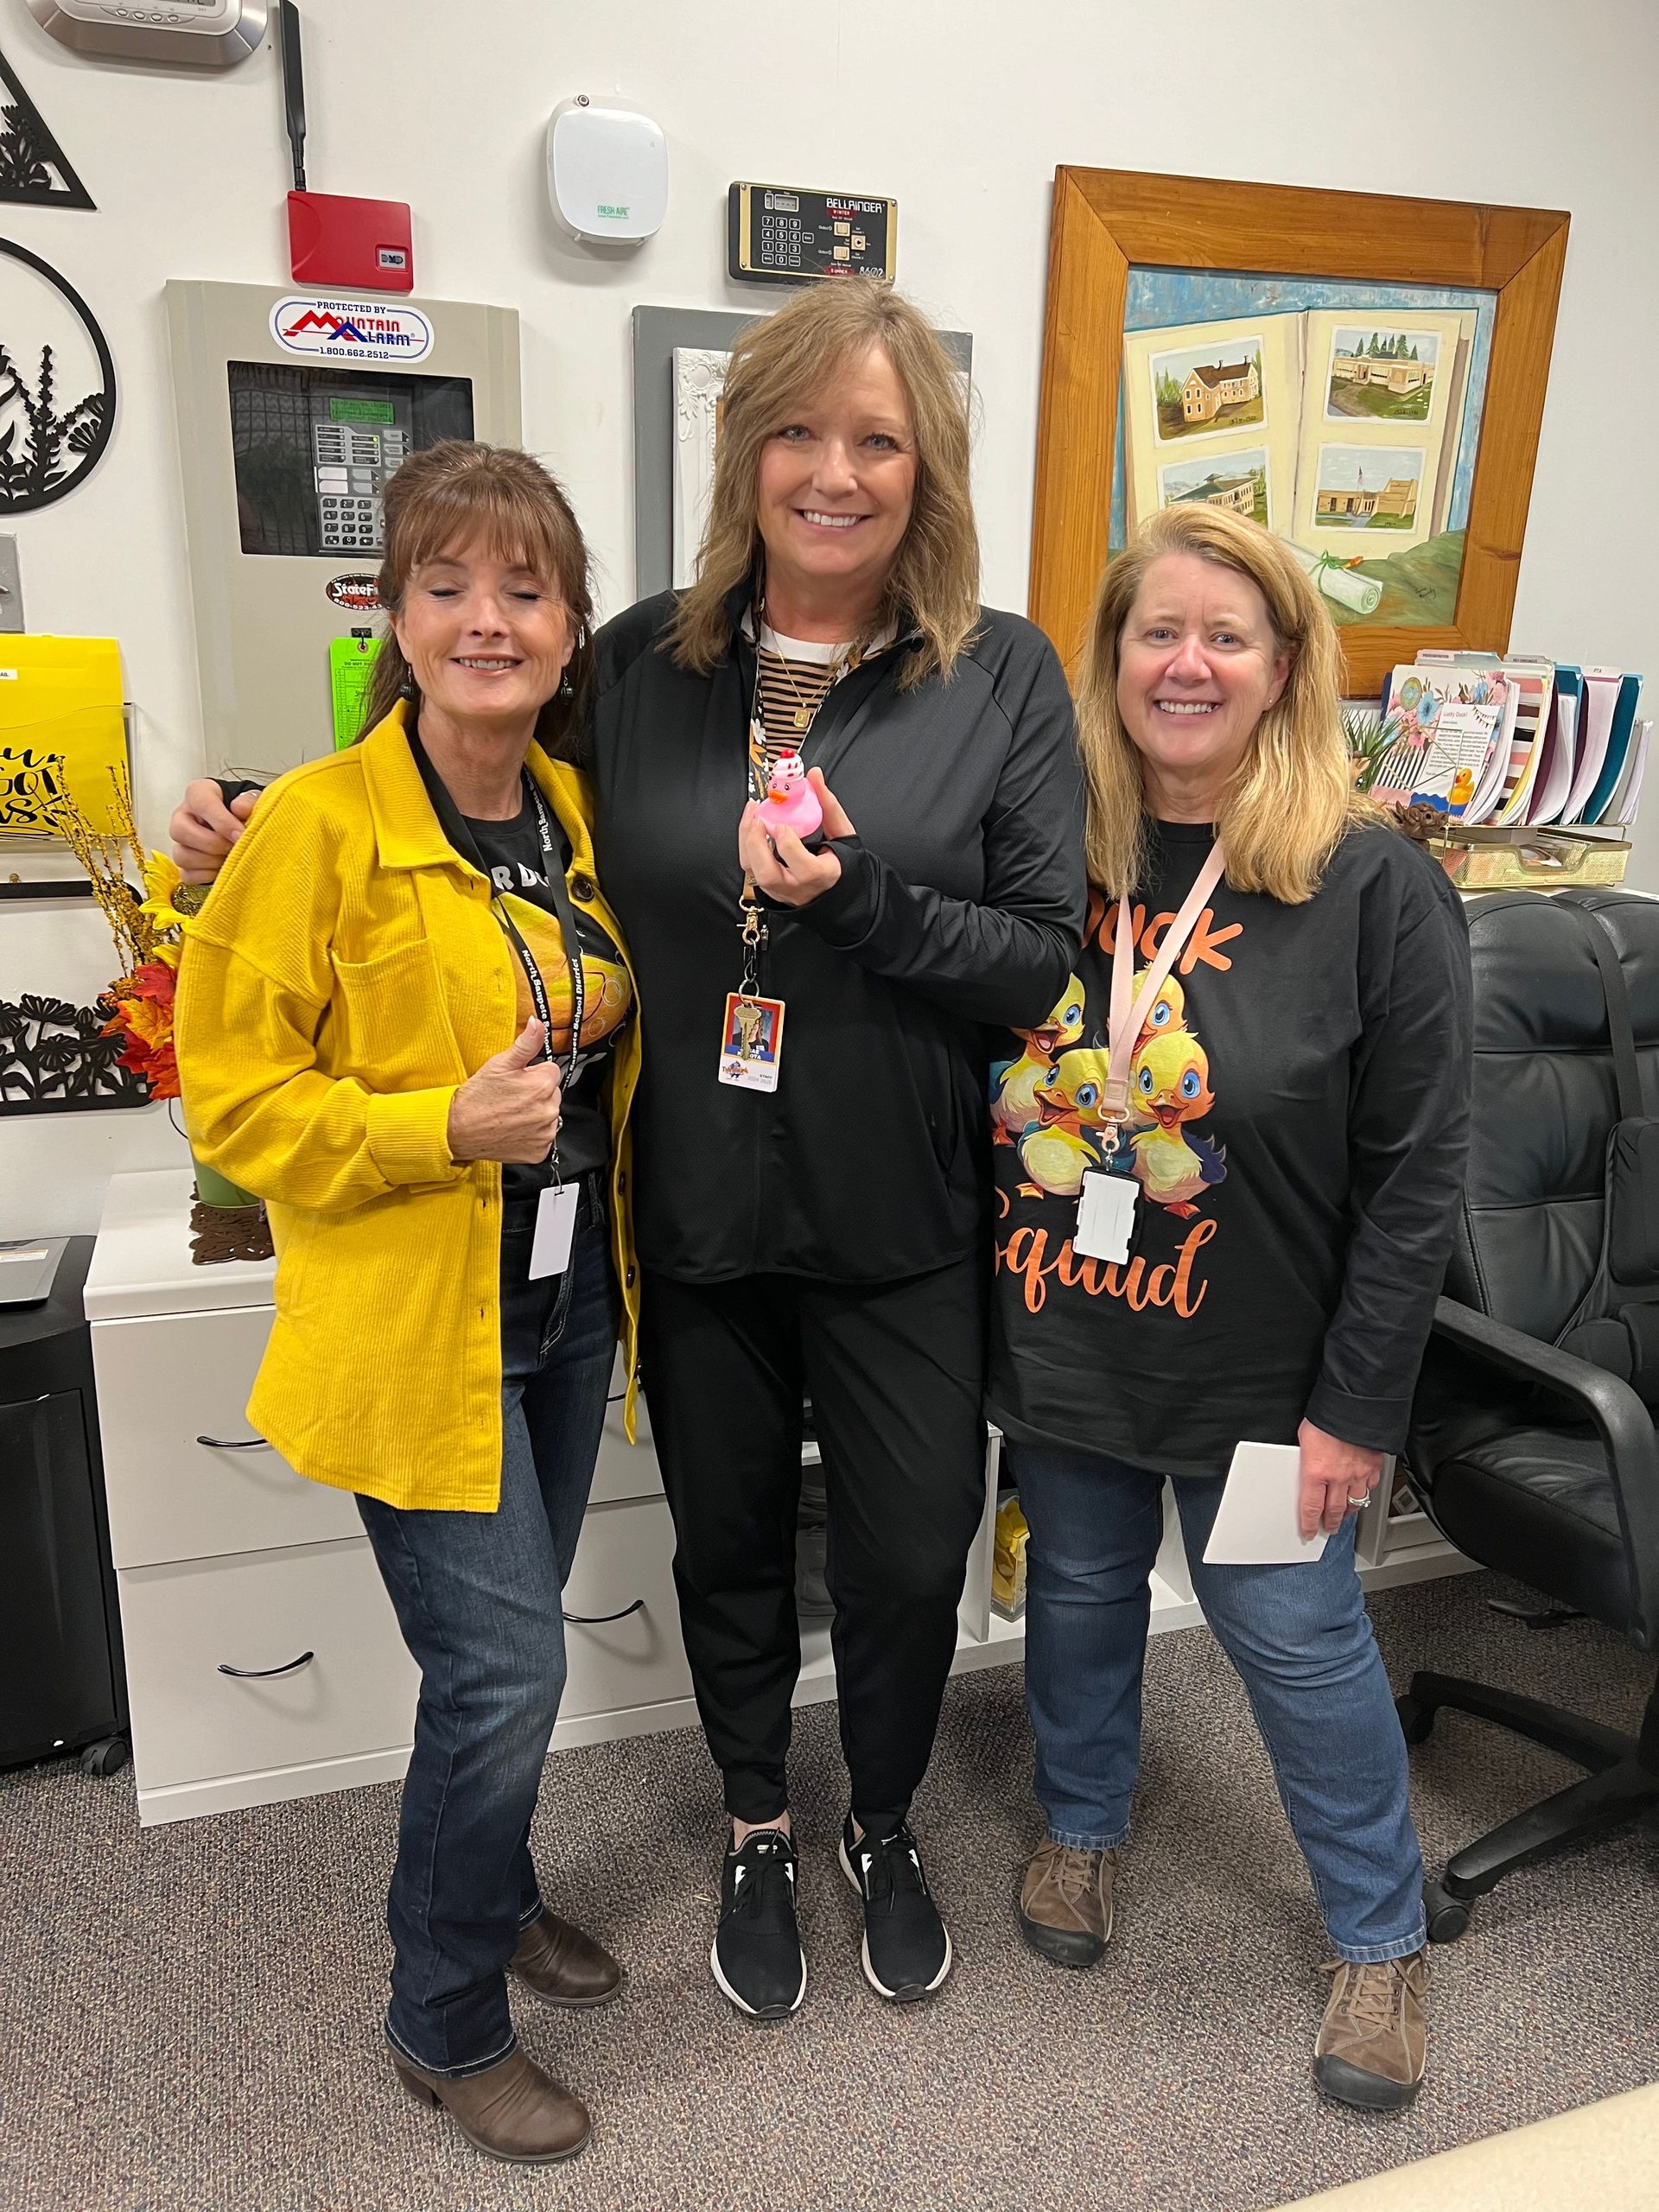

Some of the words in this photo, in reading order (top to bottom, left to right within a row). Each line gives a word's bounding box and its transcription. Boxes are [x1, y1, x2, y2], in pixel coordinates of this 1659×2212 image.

[316, 302, 372, 313] PROTECTED
[320, 346, 389, 359] 1.800.662.2512
[332, 582, 378, 597] StateFi
[539, 821, 553, 853] North
[571, 957, 582, 995] District
[521, 949, 538, 982] North
[531, 979, 548, 1020] Sanpete
[543, 1020, 554, 1055] School
[572, 996, 583, 1031] School
[569, 1032, 578, 1072] Sanpete
